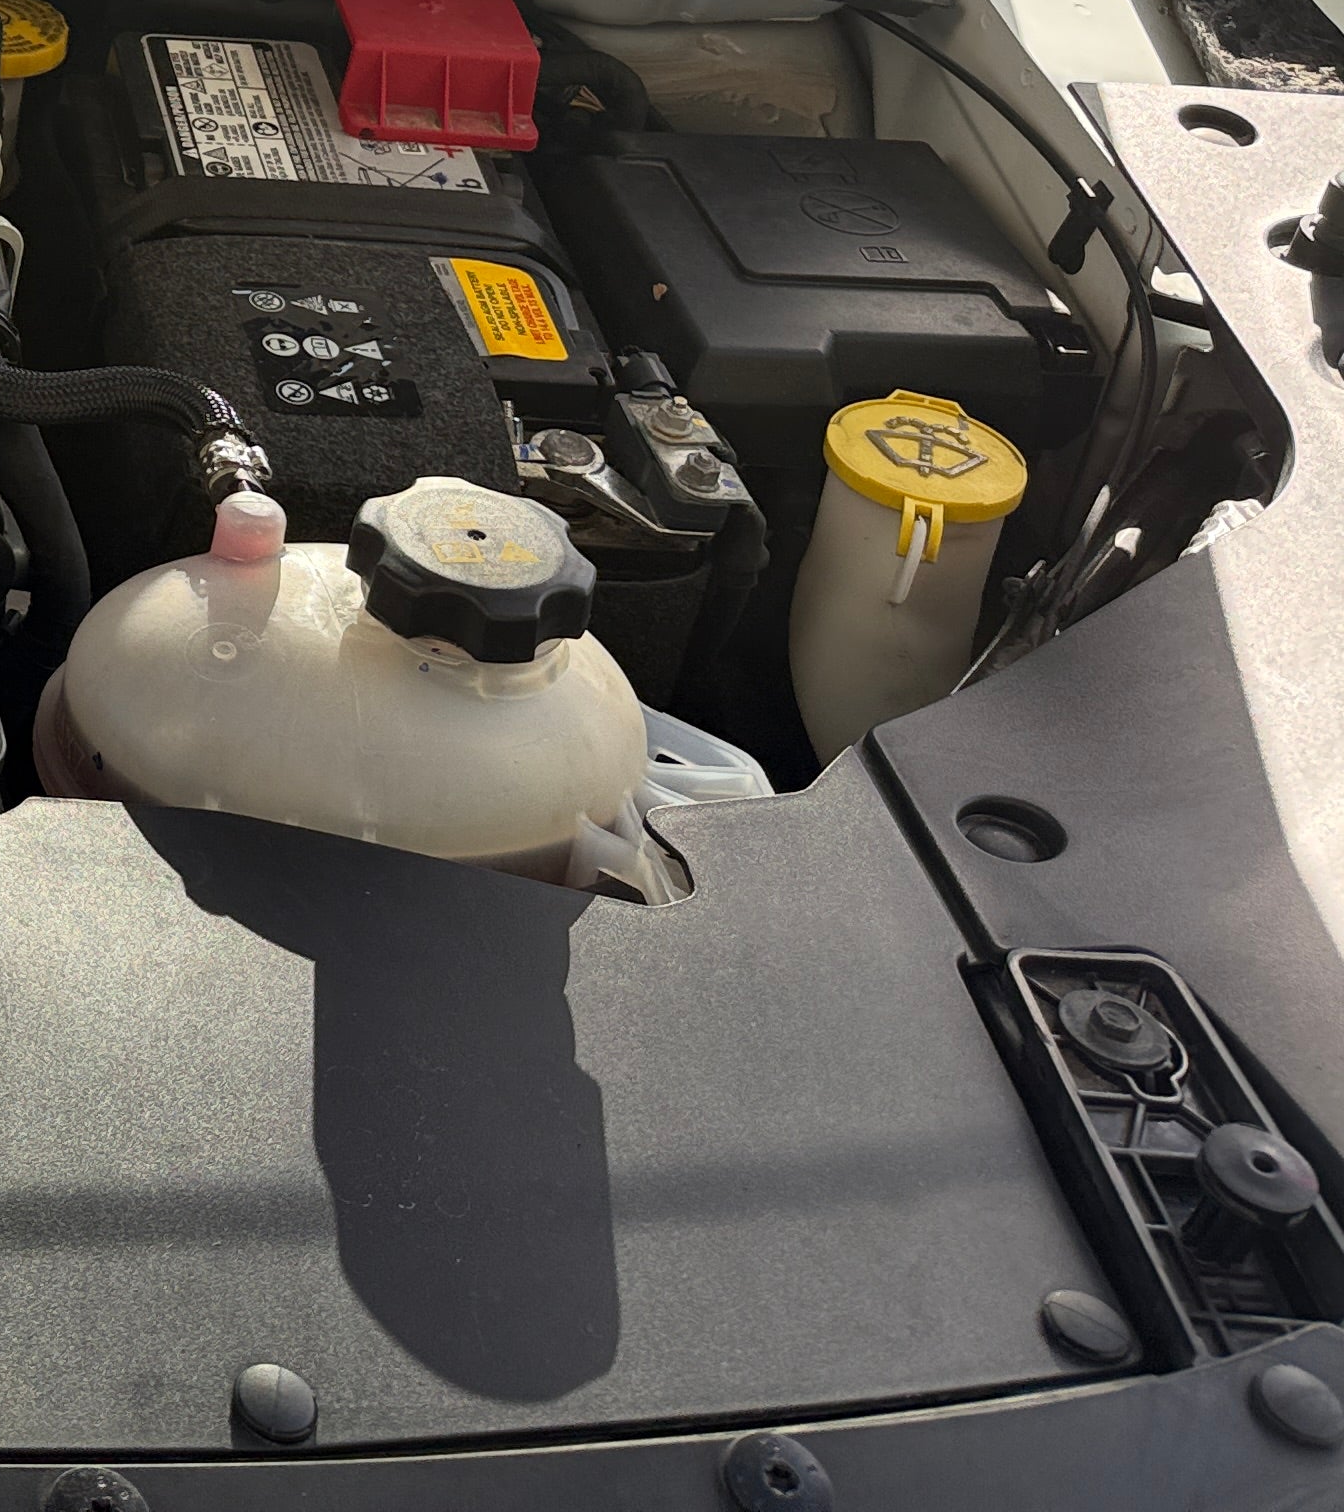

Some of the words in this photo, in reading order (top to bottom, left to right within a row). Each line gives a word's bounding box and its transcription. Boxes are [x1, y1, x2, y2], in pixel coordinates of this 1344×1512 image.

[465, 270, 486, 300] BATTERY
[484, 283, 500, 305] OPEN
[491, 305, 506, 321] NOT
[496, 282, 527, 337] NON-SPILLABLE
[498, 320, 511, 331] DO
